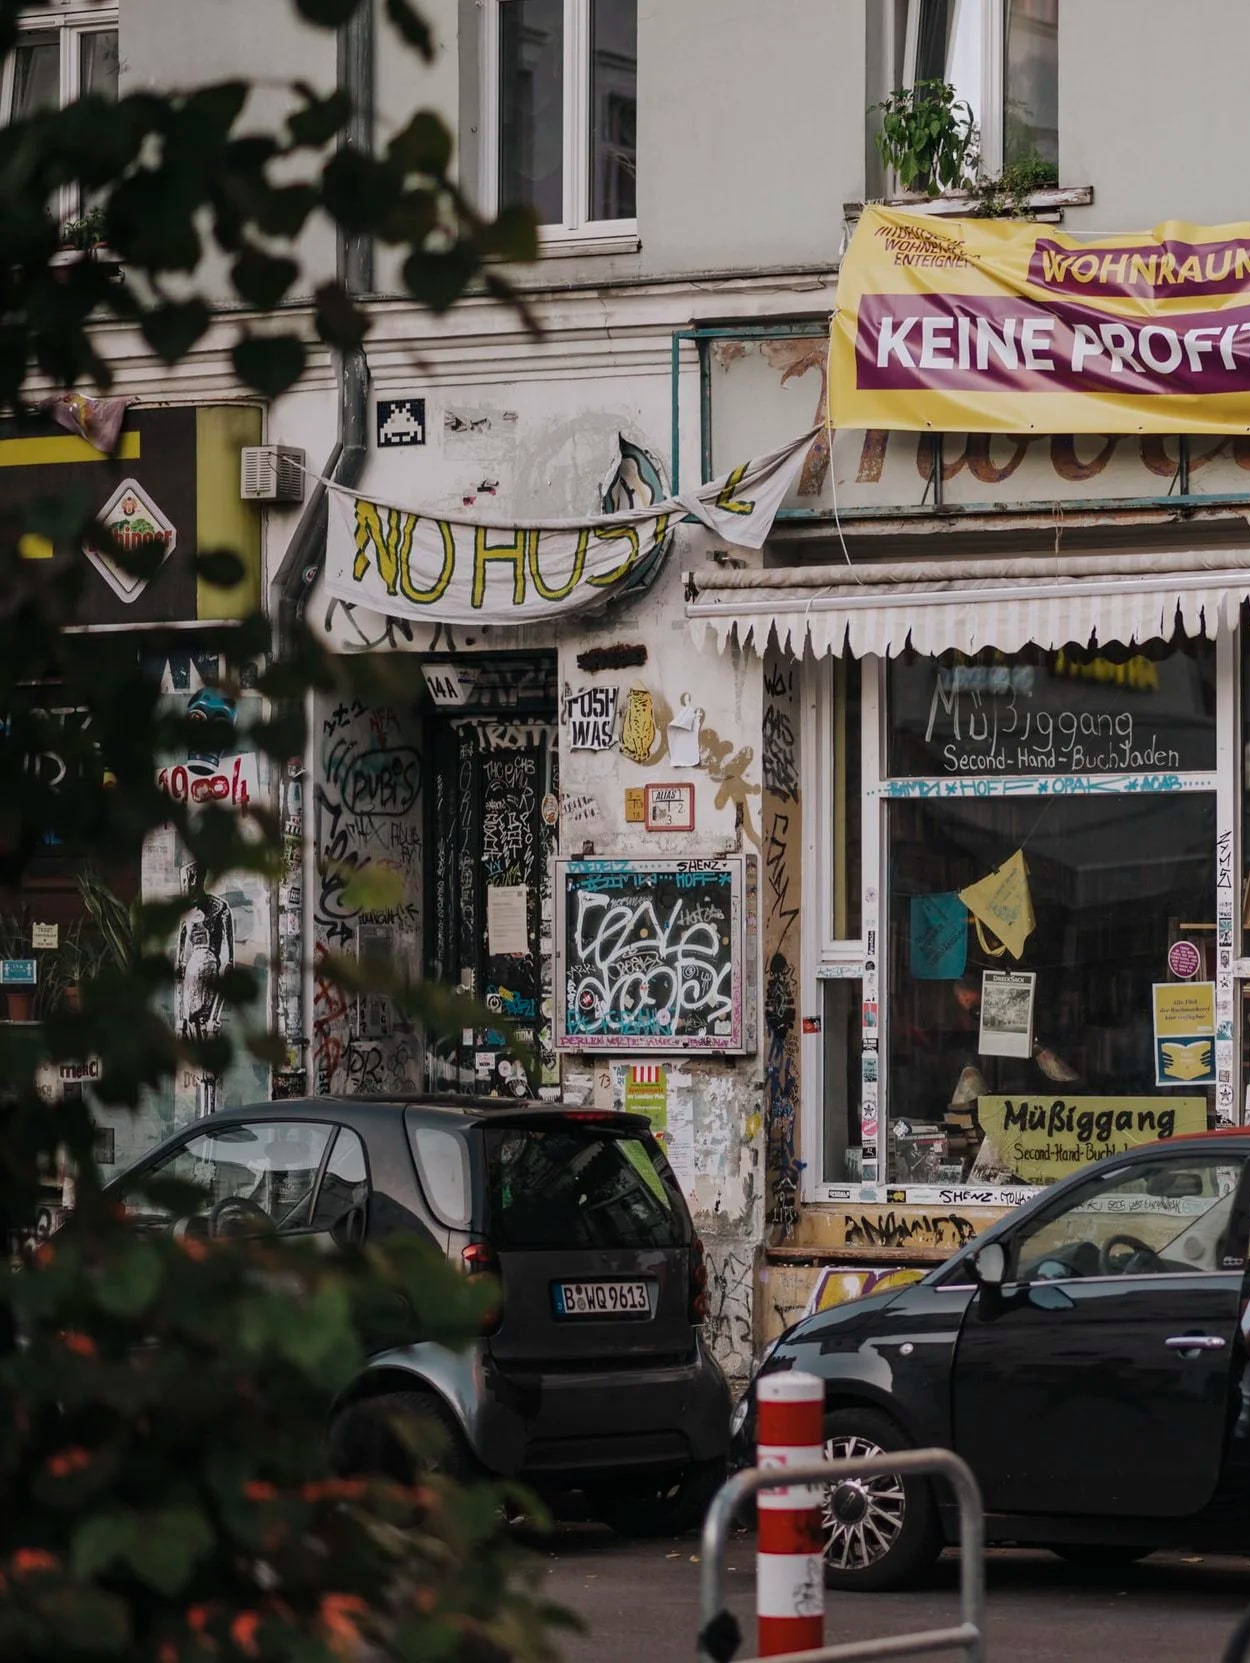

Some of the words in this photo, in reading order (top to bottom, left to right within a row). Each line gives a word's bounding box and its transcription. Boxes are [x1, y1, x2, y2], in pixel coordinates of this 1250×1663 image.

[876, 316, 1056, 371] KEINE
[353, 497, 455, 605] NO
[427, 676, 458, 699] 14A
[572, 721, 613, 748] WAS
[1003, 1100, 1176, 1142] Müßiggang
[1013, 1143, 1130, 1163] Second-Hand-Buchl
[564, 1287, 576, 1311] B
[609, 1285, 647, 1309] 9613
